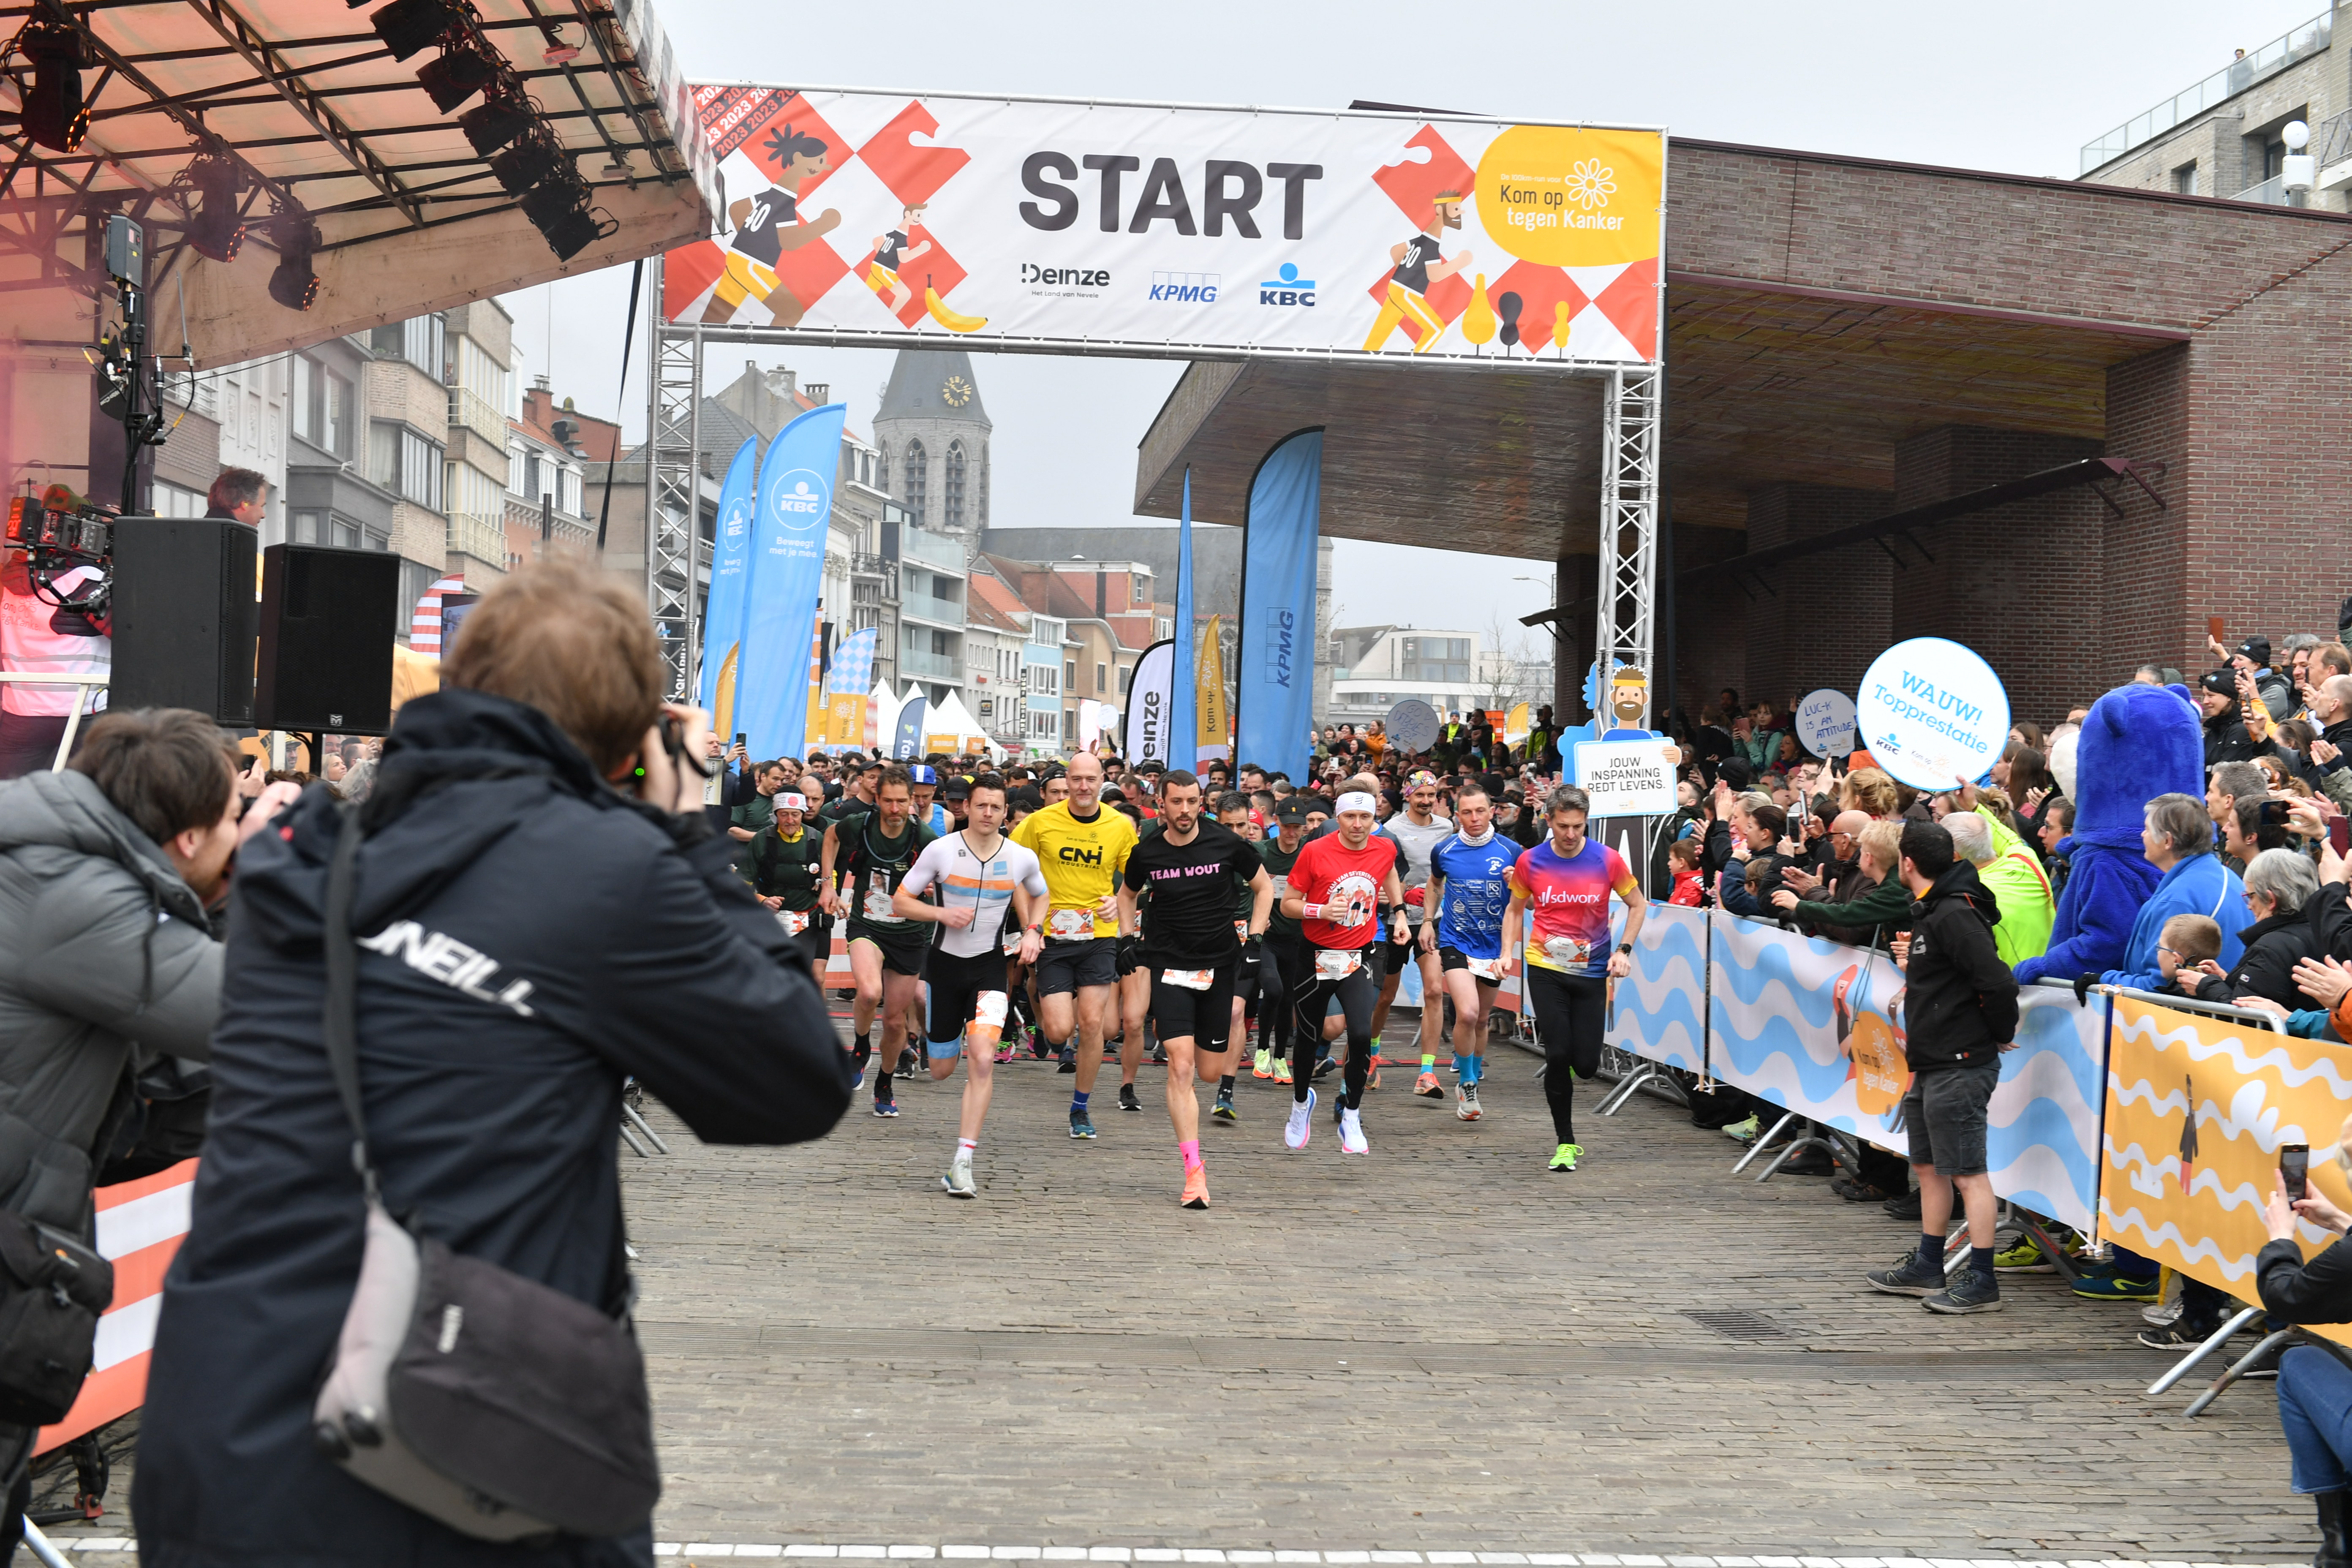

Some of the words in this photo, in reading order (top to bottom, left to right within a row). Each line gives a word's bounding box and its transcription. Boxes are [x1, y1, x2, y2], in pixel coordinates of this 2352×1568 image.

[700, 102, 725, 125] 023
[719, 100, 752, 131] 2023
[716, 126, 748, 157] 2023
[746, 99, 779, 129] 2023
[1019, 150, 1323, 240] START
[1500, 185, 1537, 204] Kom
[1544, 191, 1563, 210] op
[1507, 207, 1557, 231] tegen
[1563, 210, 1624, 230] Kanker
[880, 236, 895, 253] 10
[1149, 284, 1217, 303] KPMG
[1260, 291, 1315, 307] KBC
[781, 500, 818, 513] KBC
[776, 536, 814, 549] Beweegt
[769, 547, 787, 555] met
[788, 548, 797, 558] je
[798, 550, 818, 558] mee.
[1277, 611, 1293, 688] KPMG
[1902, 670, 1983, 726] WAUW!
[1805, 700, 1833, 716] LUC-K
[1143, 691, 1160, 758] einze
[1207, 708, 1216, 732] Kom
[1805, 721, 1815, 730] IS
[1821, 716, 1833, 726] AN
[1874, 684, 1988, 754] Topprestatie
[1816, 721, 1854, 739] ATTITUDE
[1876, 740, 1900, 755] KBC
[1609, 757, 1641, 768] JOUW
[1591, 768, 1661, 781] INSPANNING
[1587, 782, 1616, 792] REDT
[1620, 779, 1666, 791] LEVENS.
[1058, 860, 1100, 869] INDUSTRIAL
[1150, 868, 1180, 880] TEAM
[1184, 863, 1220, 877] WOUT
[1326, 881, 1338, 895] TEAM
[1336, 873, 1349, 883] VAN
[1348, 871, 1372, 881] SEVEREN
[1371, 877, 1378, 885] NV
[1489, 883, 1500, 892] RS
[1551, 890, 1601, 903] sdworx
[1857, 1048, 1873, 1066] Kom
[1872, 1056, 1880, 1073] op
[1863, 1068, 1879, 1091] tegen
[1878, 1073, 1899, 1095] Kanker
